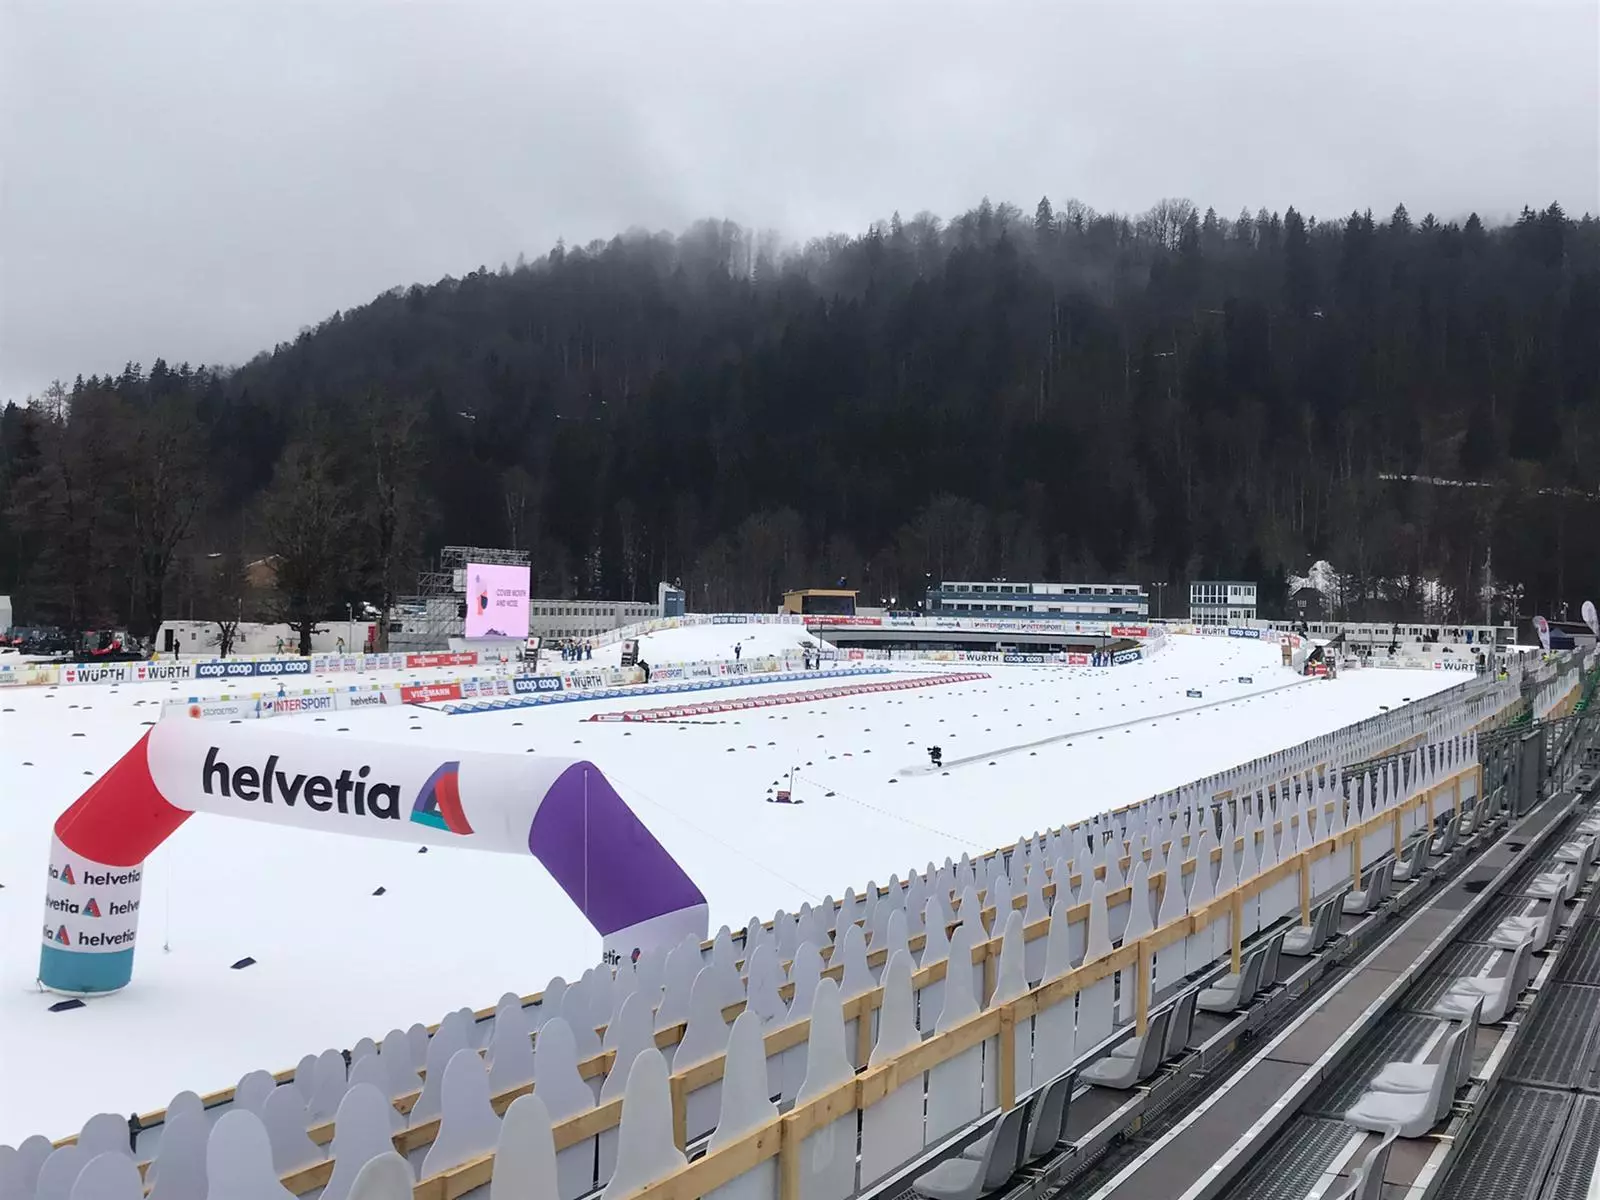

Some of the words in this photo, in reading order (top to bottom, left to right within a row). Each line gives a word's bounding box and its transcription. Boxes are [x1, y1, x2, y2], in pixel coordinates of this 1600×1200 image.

[1114, 652, 1138, 663] coop
[148, 666, 190, 679] WÜRTH
[200, 665, 226, 676] coop
[227, 664, 253, 675] coop
[259, 663, 283, 674] coop
[285, 662, 308, 672] coop
[652, 668, 683, 679] INTERSPORT
[515, 680, 537, 691] coop
[539, 679, 560, 689] coop
[273, 696, 332, 713] INTERSPORT
[350, 692, 378, 706] helvetia
[202, 746, 401, 820] helvetia
